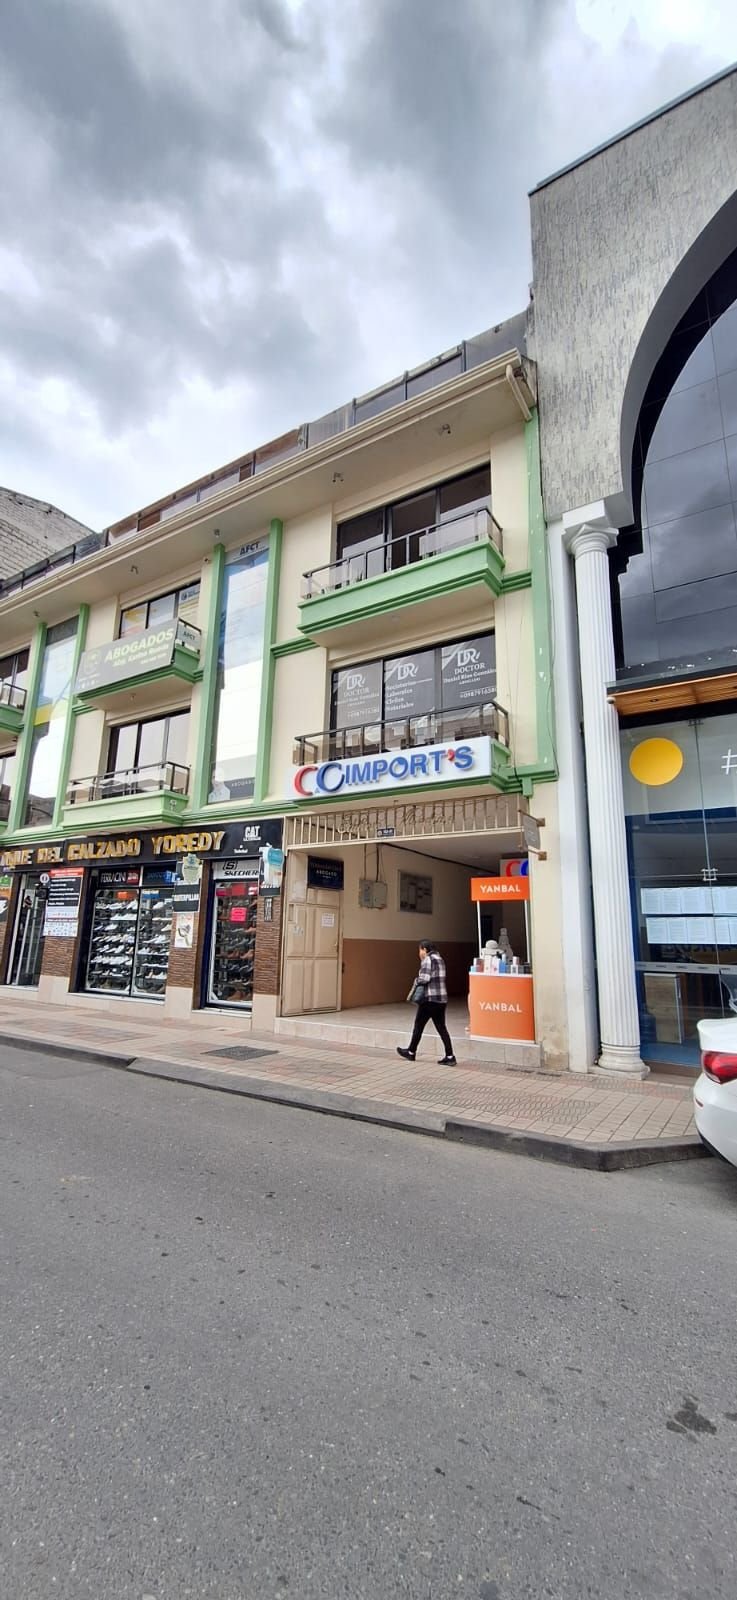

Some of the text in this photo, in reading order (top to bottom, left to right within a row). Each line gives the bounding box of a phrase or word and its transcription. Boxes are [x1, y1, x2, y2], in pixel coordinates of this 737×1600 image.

[240, 541, 259, 555] AFCT
[105, 628, 174, 662] ABOGADOS
[454, 662, 485, 675] DOCTOR
[345, 746, 474, 784] IMPORT'S
[244, 826, 260, 838] CAT
[37, 847, 64, 864] DEL
[67, 838, 141, 861] CALZADO
[151, 831, 225, 855] YOREDY
[480, 884, 521, 894] YANBAL
[479, 1001, 522, 1013] YANBAL
